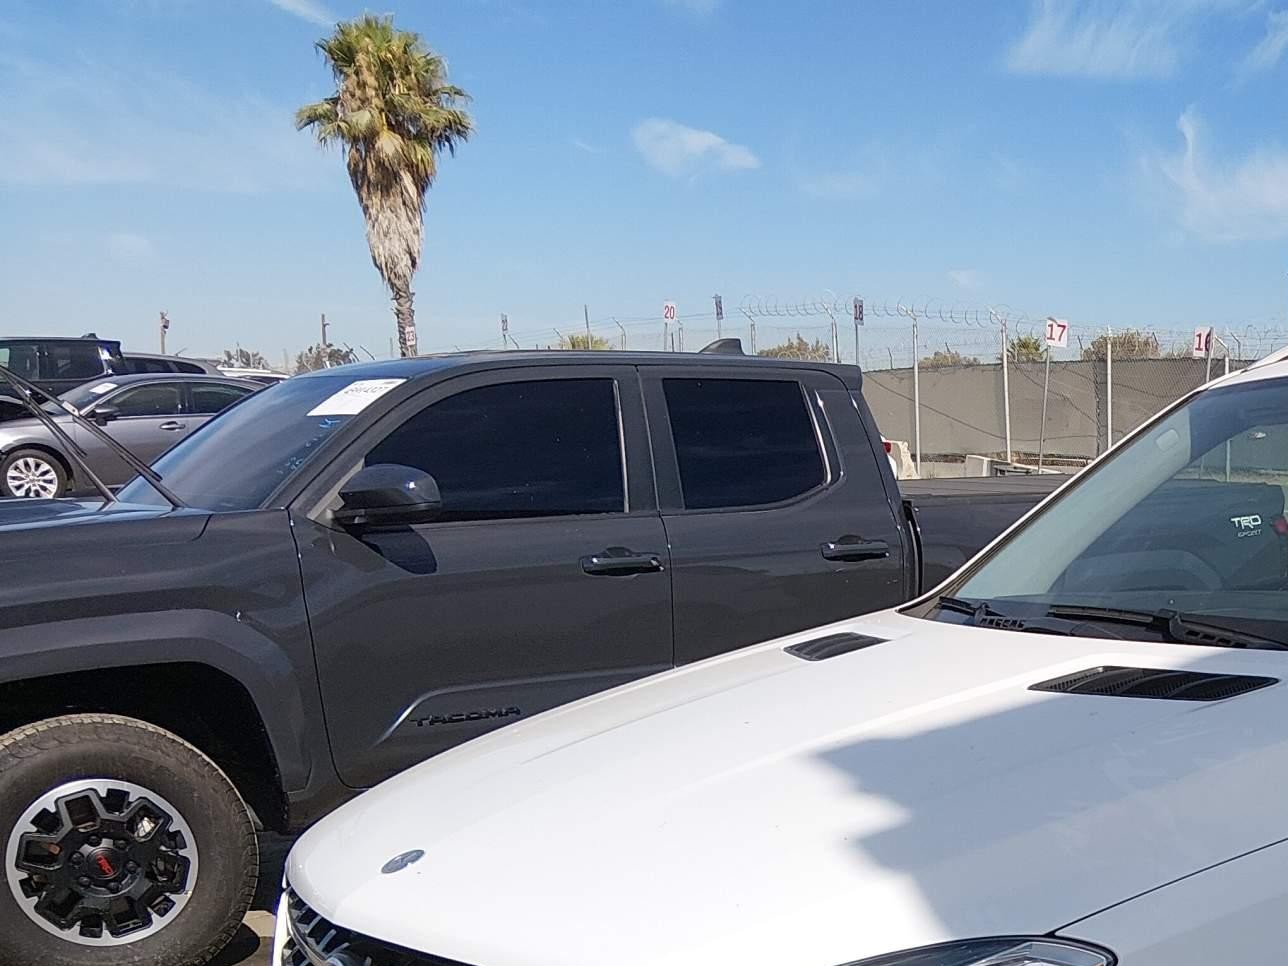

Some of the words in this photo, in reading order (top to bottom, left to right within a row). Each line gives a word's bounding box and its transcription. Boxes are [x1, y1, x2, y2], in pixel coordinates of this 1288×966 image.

[664, 305, 675, 320] 20
[854, 304, 864, 321] 18
[406, 330, 415, 341] 23
[1046, 323, 1067, 342] 17
[1230, 514, 1262, 530] TRD
[408, 706, 520, 727] TACOMA
